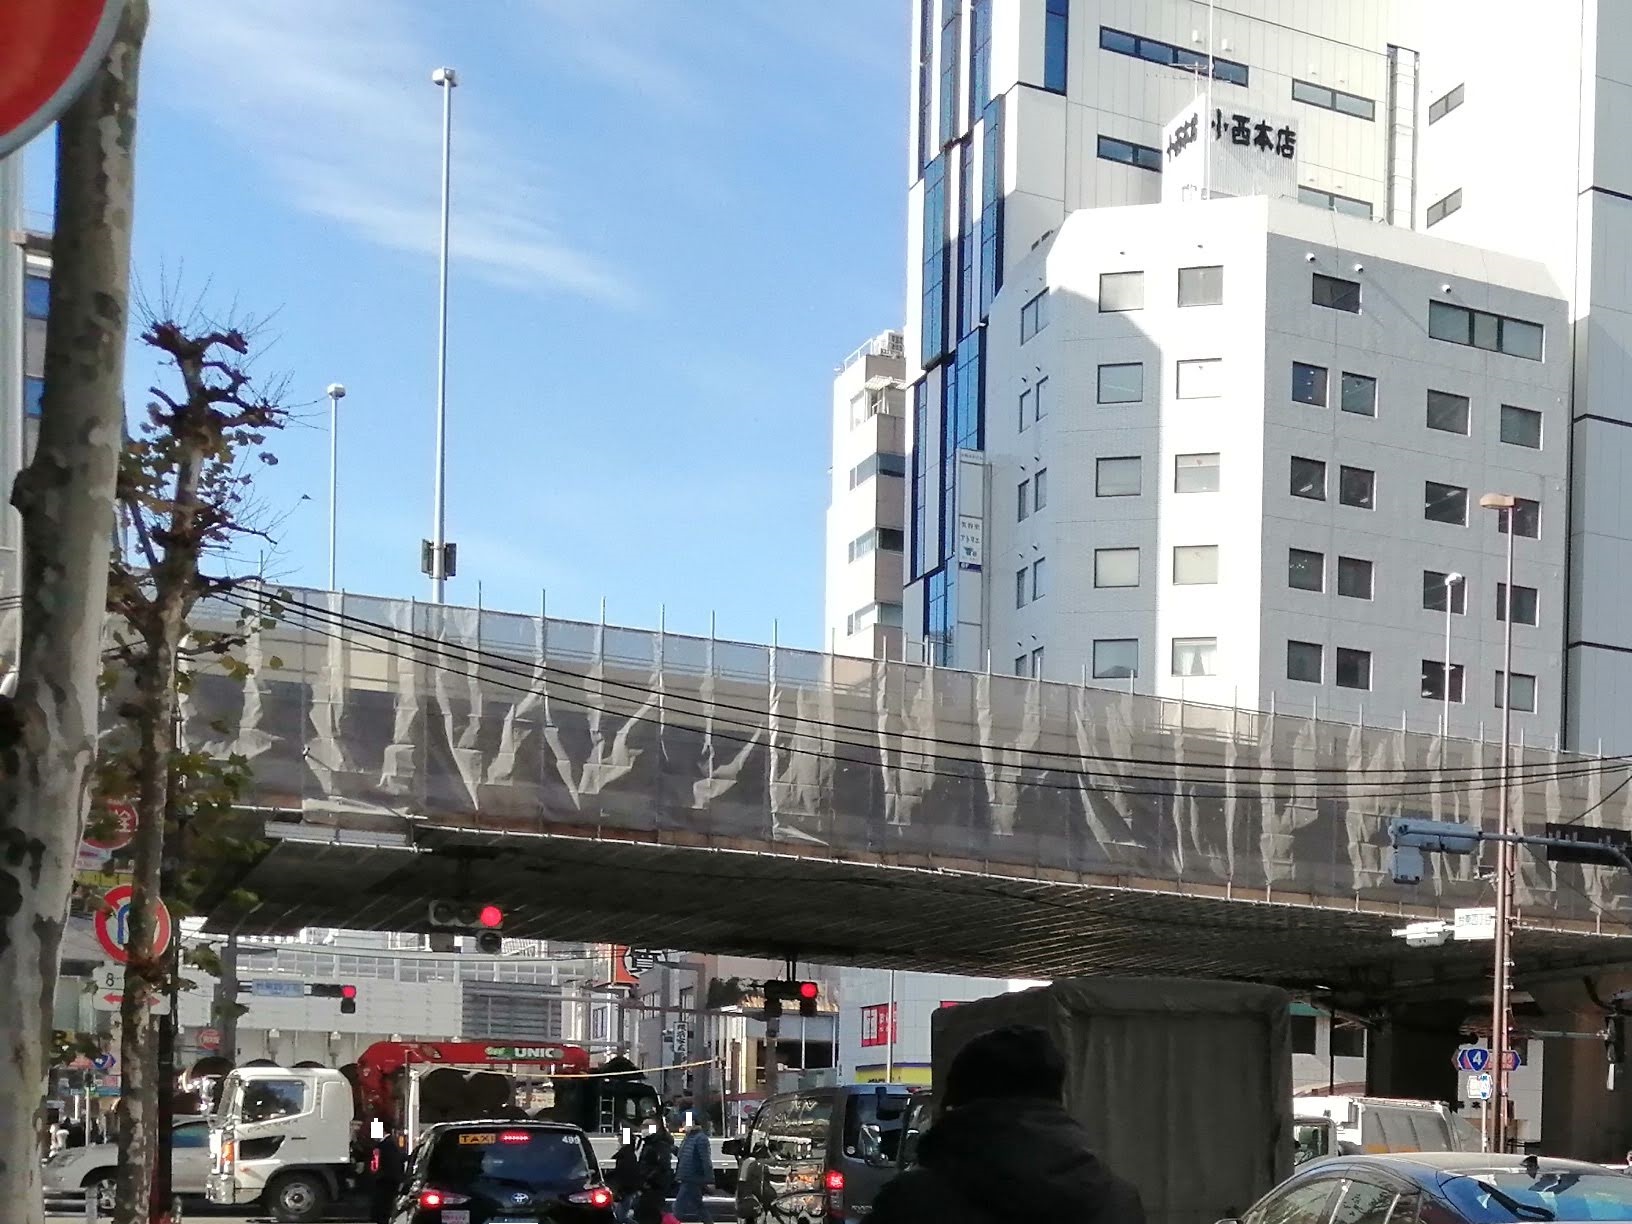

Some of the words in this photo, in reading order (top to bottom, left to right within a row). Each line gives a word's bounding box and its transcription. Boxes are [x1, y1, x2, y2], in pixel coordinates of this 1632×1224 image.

[1211, 107, 1297, 160] 小西本店
[514, 1047, 555, 1058] UNIC
[1472, 1051, 1483, 1066] 4
[460, 1135, 495, 1143] TAXI
